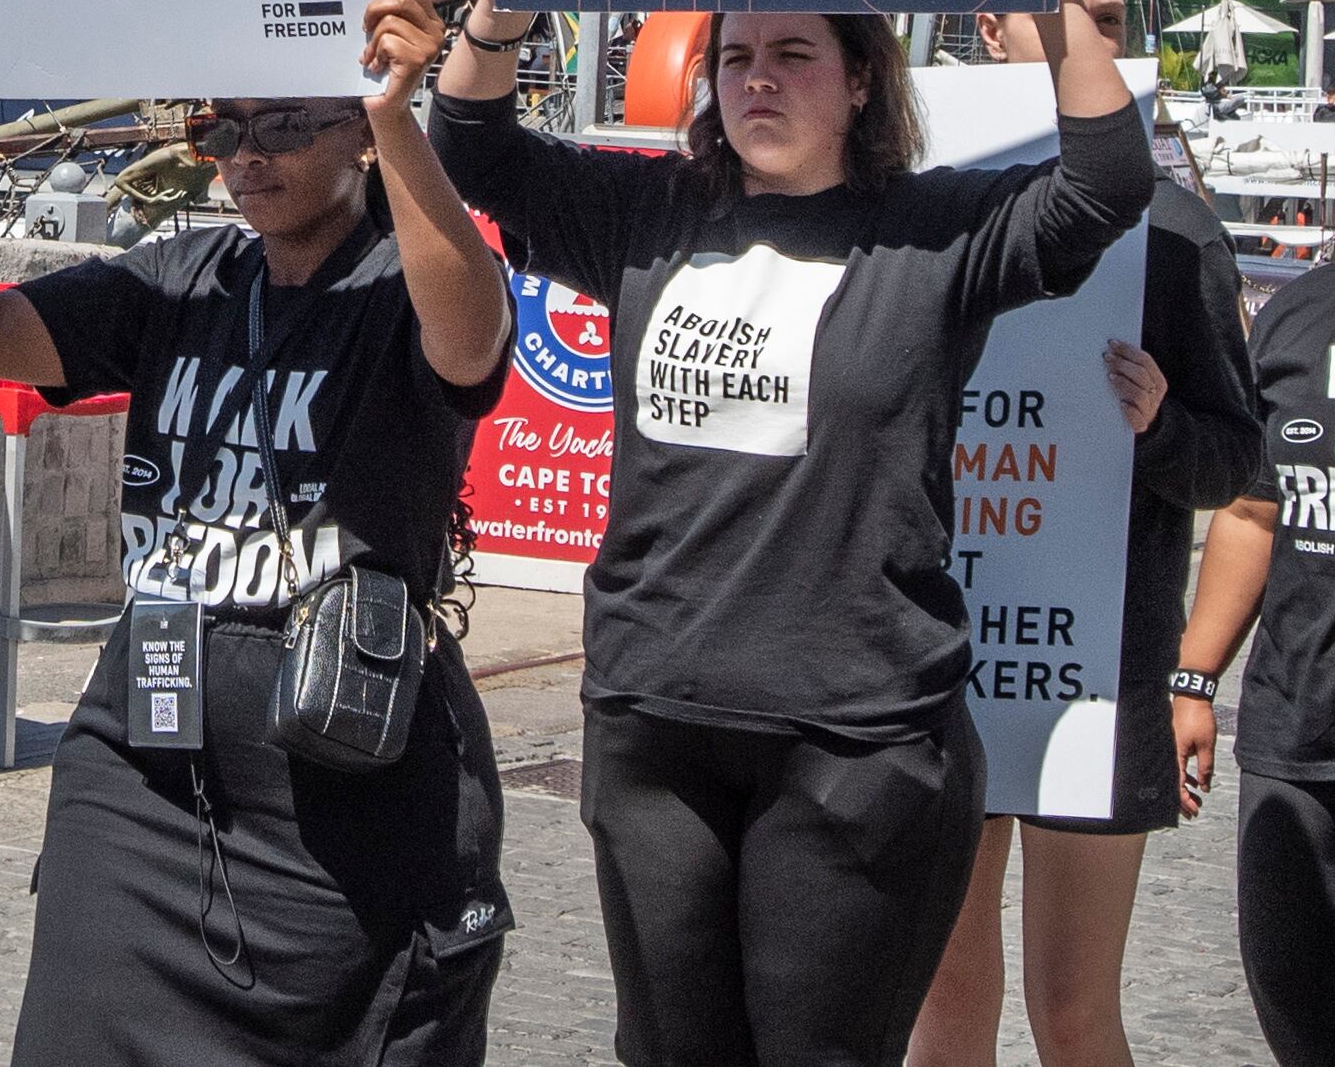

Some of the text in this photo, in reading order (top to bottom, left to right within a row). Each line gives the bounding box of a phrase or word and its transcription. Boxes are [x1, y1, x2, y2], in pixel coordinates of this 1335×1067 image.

[261, 3, 296, 18] FOR
[264, 21, 346, 38] FREEDOM
[664, 305, 771, 347] ABOLISH
[523, 331, 611, 391] CHART
[654, 330, 764, 370] SLAVERY
[650, 360, 790, 404] WITH EACH
[651, 393, 710, 428] STEP
[957, 390, 1045, 429] FOR
[493, 416, 541, 450] The
[498, 464, 571, 492] CAPE
[530, 499, 568, 516] EST
[980, 605, 1075, 647] HER
[142, 641, 185, 652] KNOW THE
[145, 653, 183, 664] SIGNS OF
[136, 677, 193, 689] TRAFFICKING.
[149, 665, 179, 676] HUMAN
